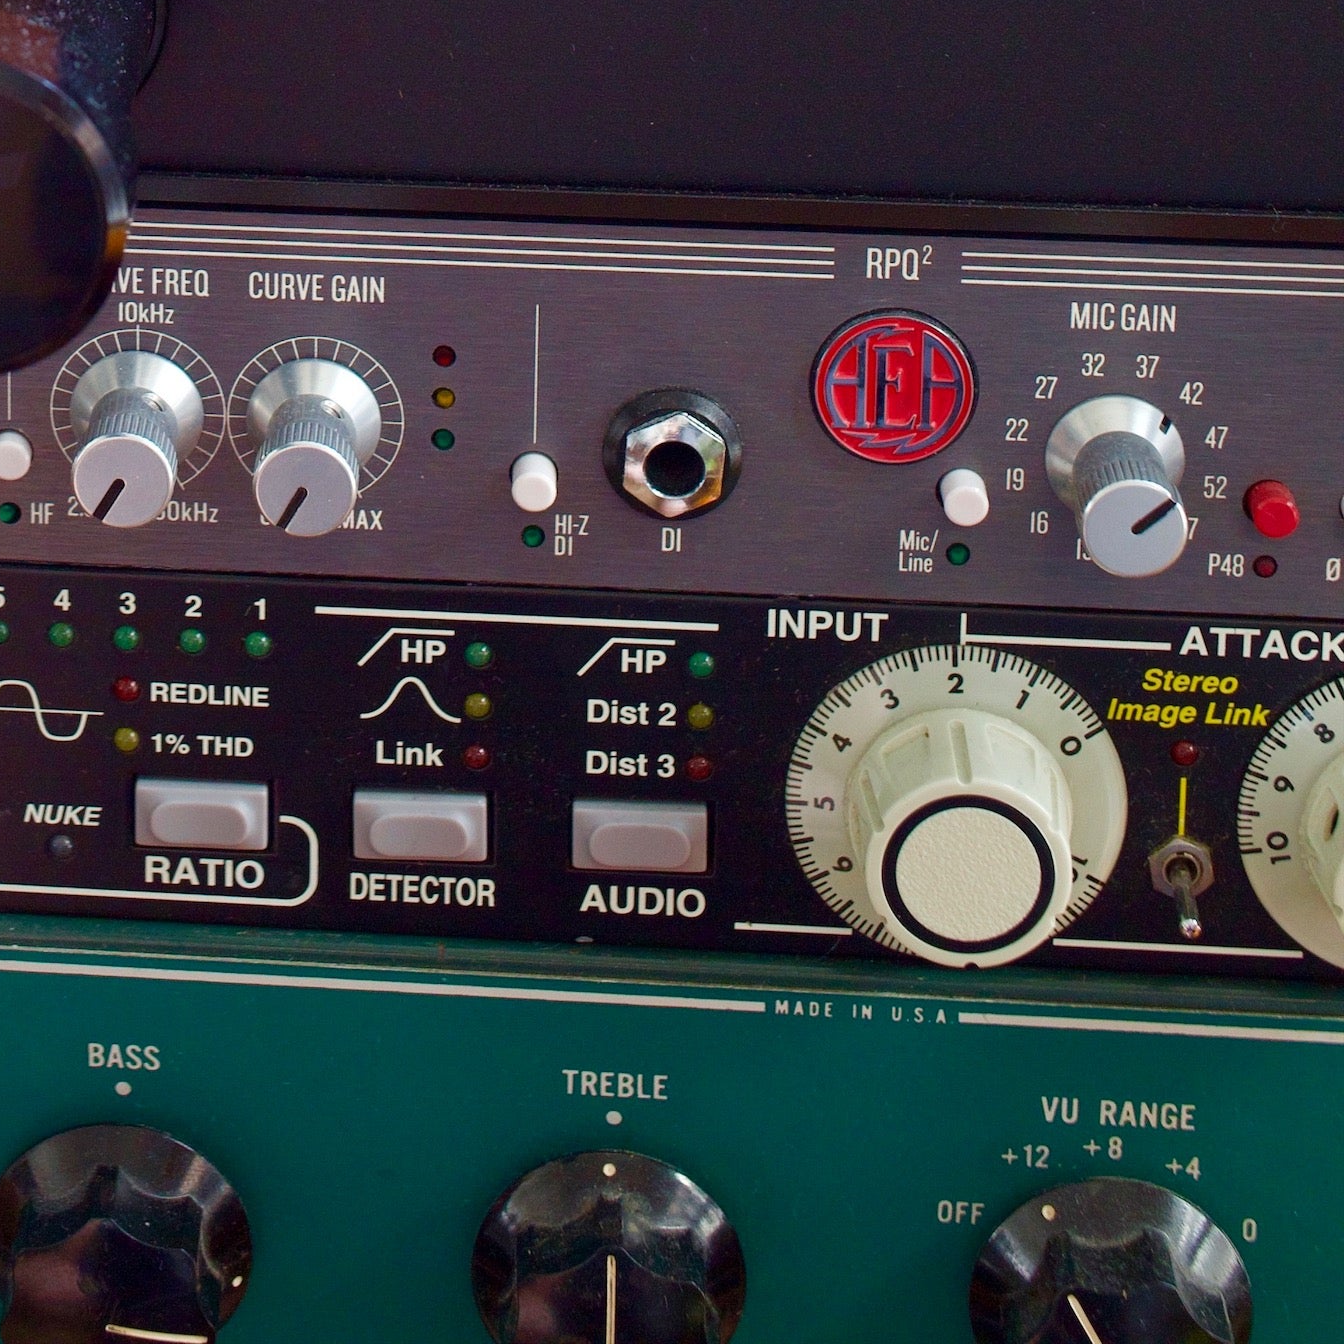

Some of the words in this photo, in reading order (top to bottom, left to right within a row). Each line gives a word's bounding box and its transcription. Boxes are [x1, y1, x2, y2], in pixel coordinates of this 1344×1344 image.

[152, 268, 210, 297] FREQ
[248, 272, 324, 301] CURVE
[331, 275, 385, 303] GAIN
[118, 301, 174, 324] 10kHz
[1071, 302, 1115, 330] MIC
[1120, 304, 1177, 333] GAIN
[1081, 353, 1105, 377] 32
[1135, 355, 1160, 379] 37
[1179, 382, 1204, 406] 42
[1203, 475, 1227, 500] 52
[30, 501, 54, 525] HF
[338, 509, 383, 531] MAX
[554, 513, 590, 537] HI-Z
[1030, 511, 1049, 534] 16
[554, 535, 574, 557] DI
[661, 526, 682, 553] DI
[899, 529, 939, 552] Mic/
[898, 550, 933, 573] Line
[1209, 552, 1245, 577] P48
[53, 589, 72, 612] 4
[118, 591, 137, 615] 3
[184, 595, 203, 618] 2
[253, 598, 267, 621] 1
[766, 608, 890, 643] INPUT
[400, 638, 447, 665] HP
[1179, 625, 1344, 662] ATTACK
[620, 648, 668, 675] HP
[947, 673, 966, 696] 2
[1142, 667, 1239, 695] Stereo
[149, 682, 270, 709] REDLINE
[879, 688, 901, 711] 3
[587, 698, 650, 726] Dist
[656, 702, 678, 727] 2
[1107, 697, 1196, 728] Image
[1204, 700, 1272, 728] Link
[150, 733, 191, 757] 1%
[196, 734, 254, 758] THD
[1059, 734, 1083, 758] 0
[1313, 722, 1336, 745] 8
[375, 740, 445, 768] Link
[585, 750, 650, 778] Dist
[656, 754, 676, 779] 3
[23, 802, 103, 828] NUKE
[1265, 830, 1292, 866] 10
[143, 857, 266, 890] RATIO
[348, 872, 496, 909] DETECTOR
[579, 884, 707, 919] AUDIO
[775, 999, 833, 1018] MADE
[852, 1003, 873, 1020] IN
[87, 1042, 161, 1071] BASS
[561, 1069, 668, 1100] TREBLE
[1040, 1095, 1080, 1124] VU
[1099, 1099, 1197, 1131] RANGE
[1001, 1144, 1050, 1170] +12
[1082, 1135, 1123, 1161] +8
[1164, 1156, 1202, 1181] +4
[937, 1200, 986, 1226] OFF
[1242, 1217, 1258, 1243] 0
